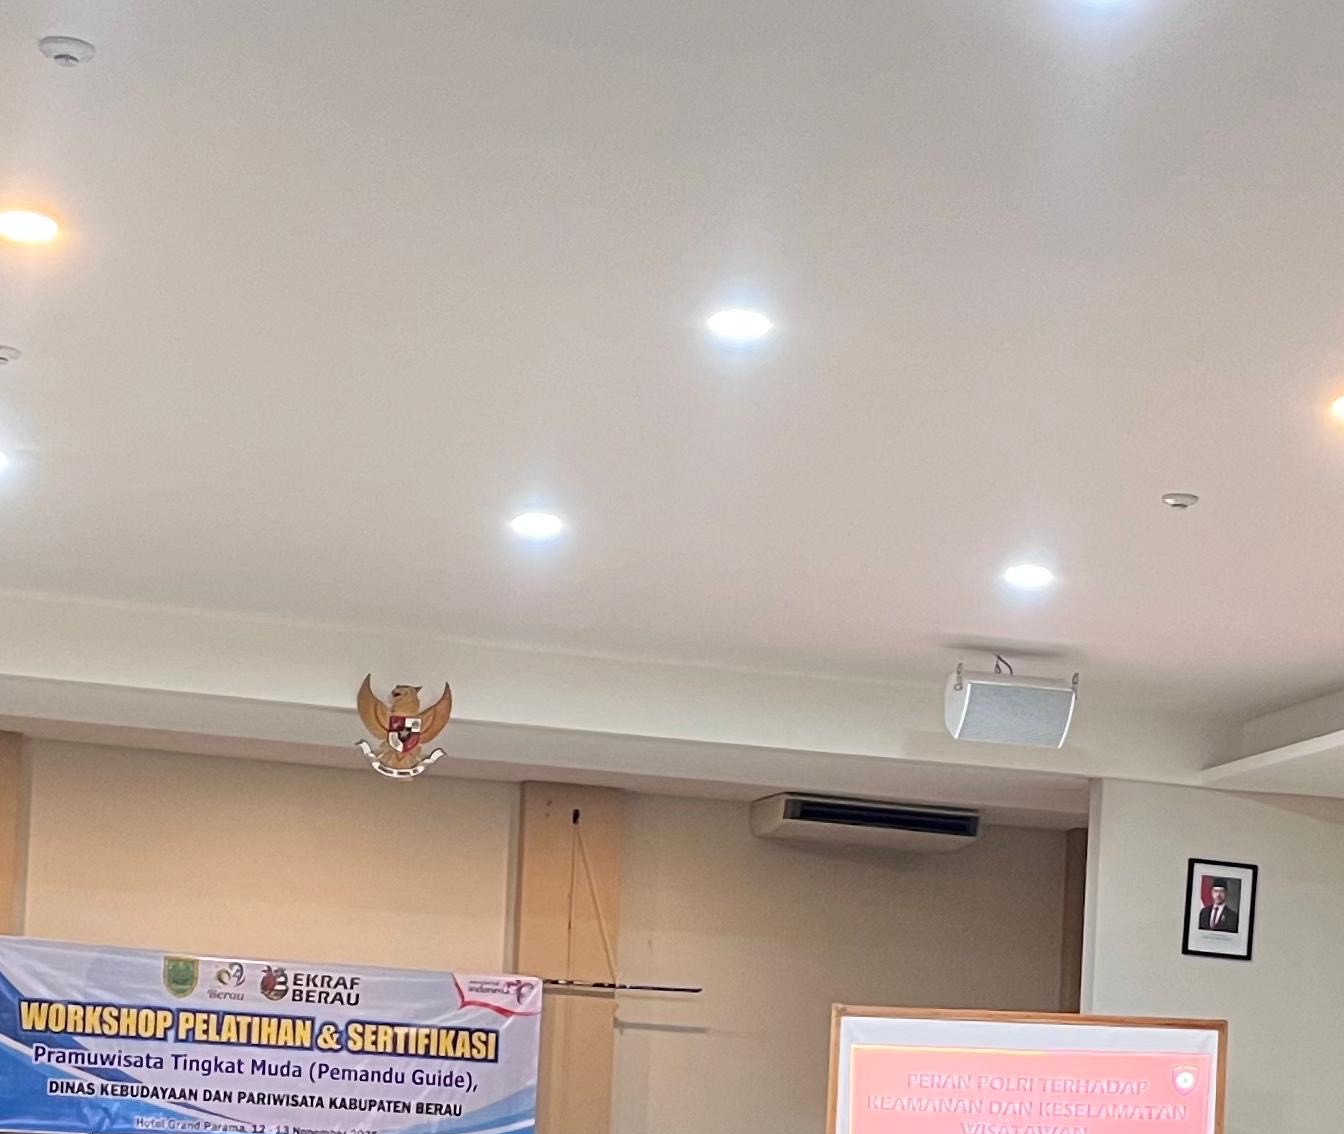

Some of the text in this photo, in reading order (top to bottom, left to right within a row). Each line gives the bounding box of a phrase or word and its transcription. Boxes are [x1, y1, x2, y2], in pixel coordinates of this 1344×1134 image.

[293, 973, 361, 989] EKRAF
[291, 989, 360, 1006] BERAU
[20, 1001, 498, 1061] WORKSHOP PELATIHAN & SERTIFIKASI
[33, 1046, 478, 1093] Pramuwisata Tingkat Muda (Pemandu Guide),
[907, 1073, 1148, 1095] PERAN POLRI TERHADAP
[49, 1081, 462, 1117] DINAS KEBUDAYAAN DAN PARIWISATA KABUPATEN BERAU
[867, 1096, 1187, 1120] KEAMANAN DAN KESELAMATAN
[168, 1120, 200, 1130] Grand
[252, 1125, 265, 1134] 12
